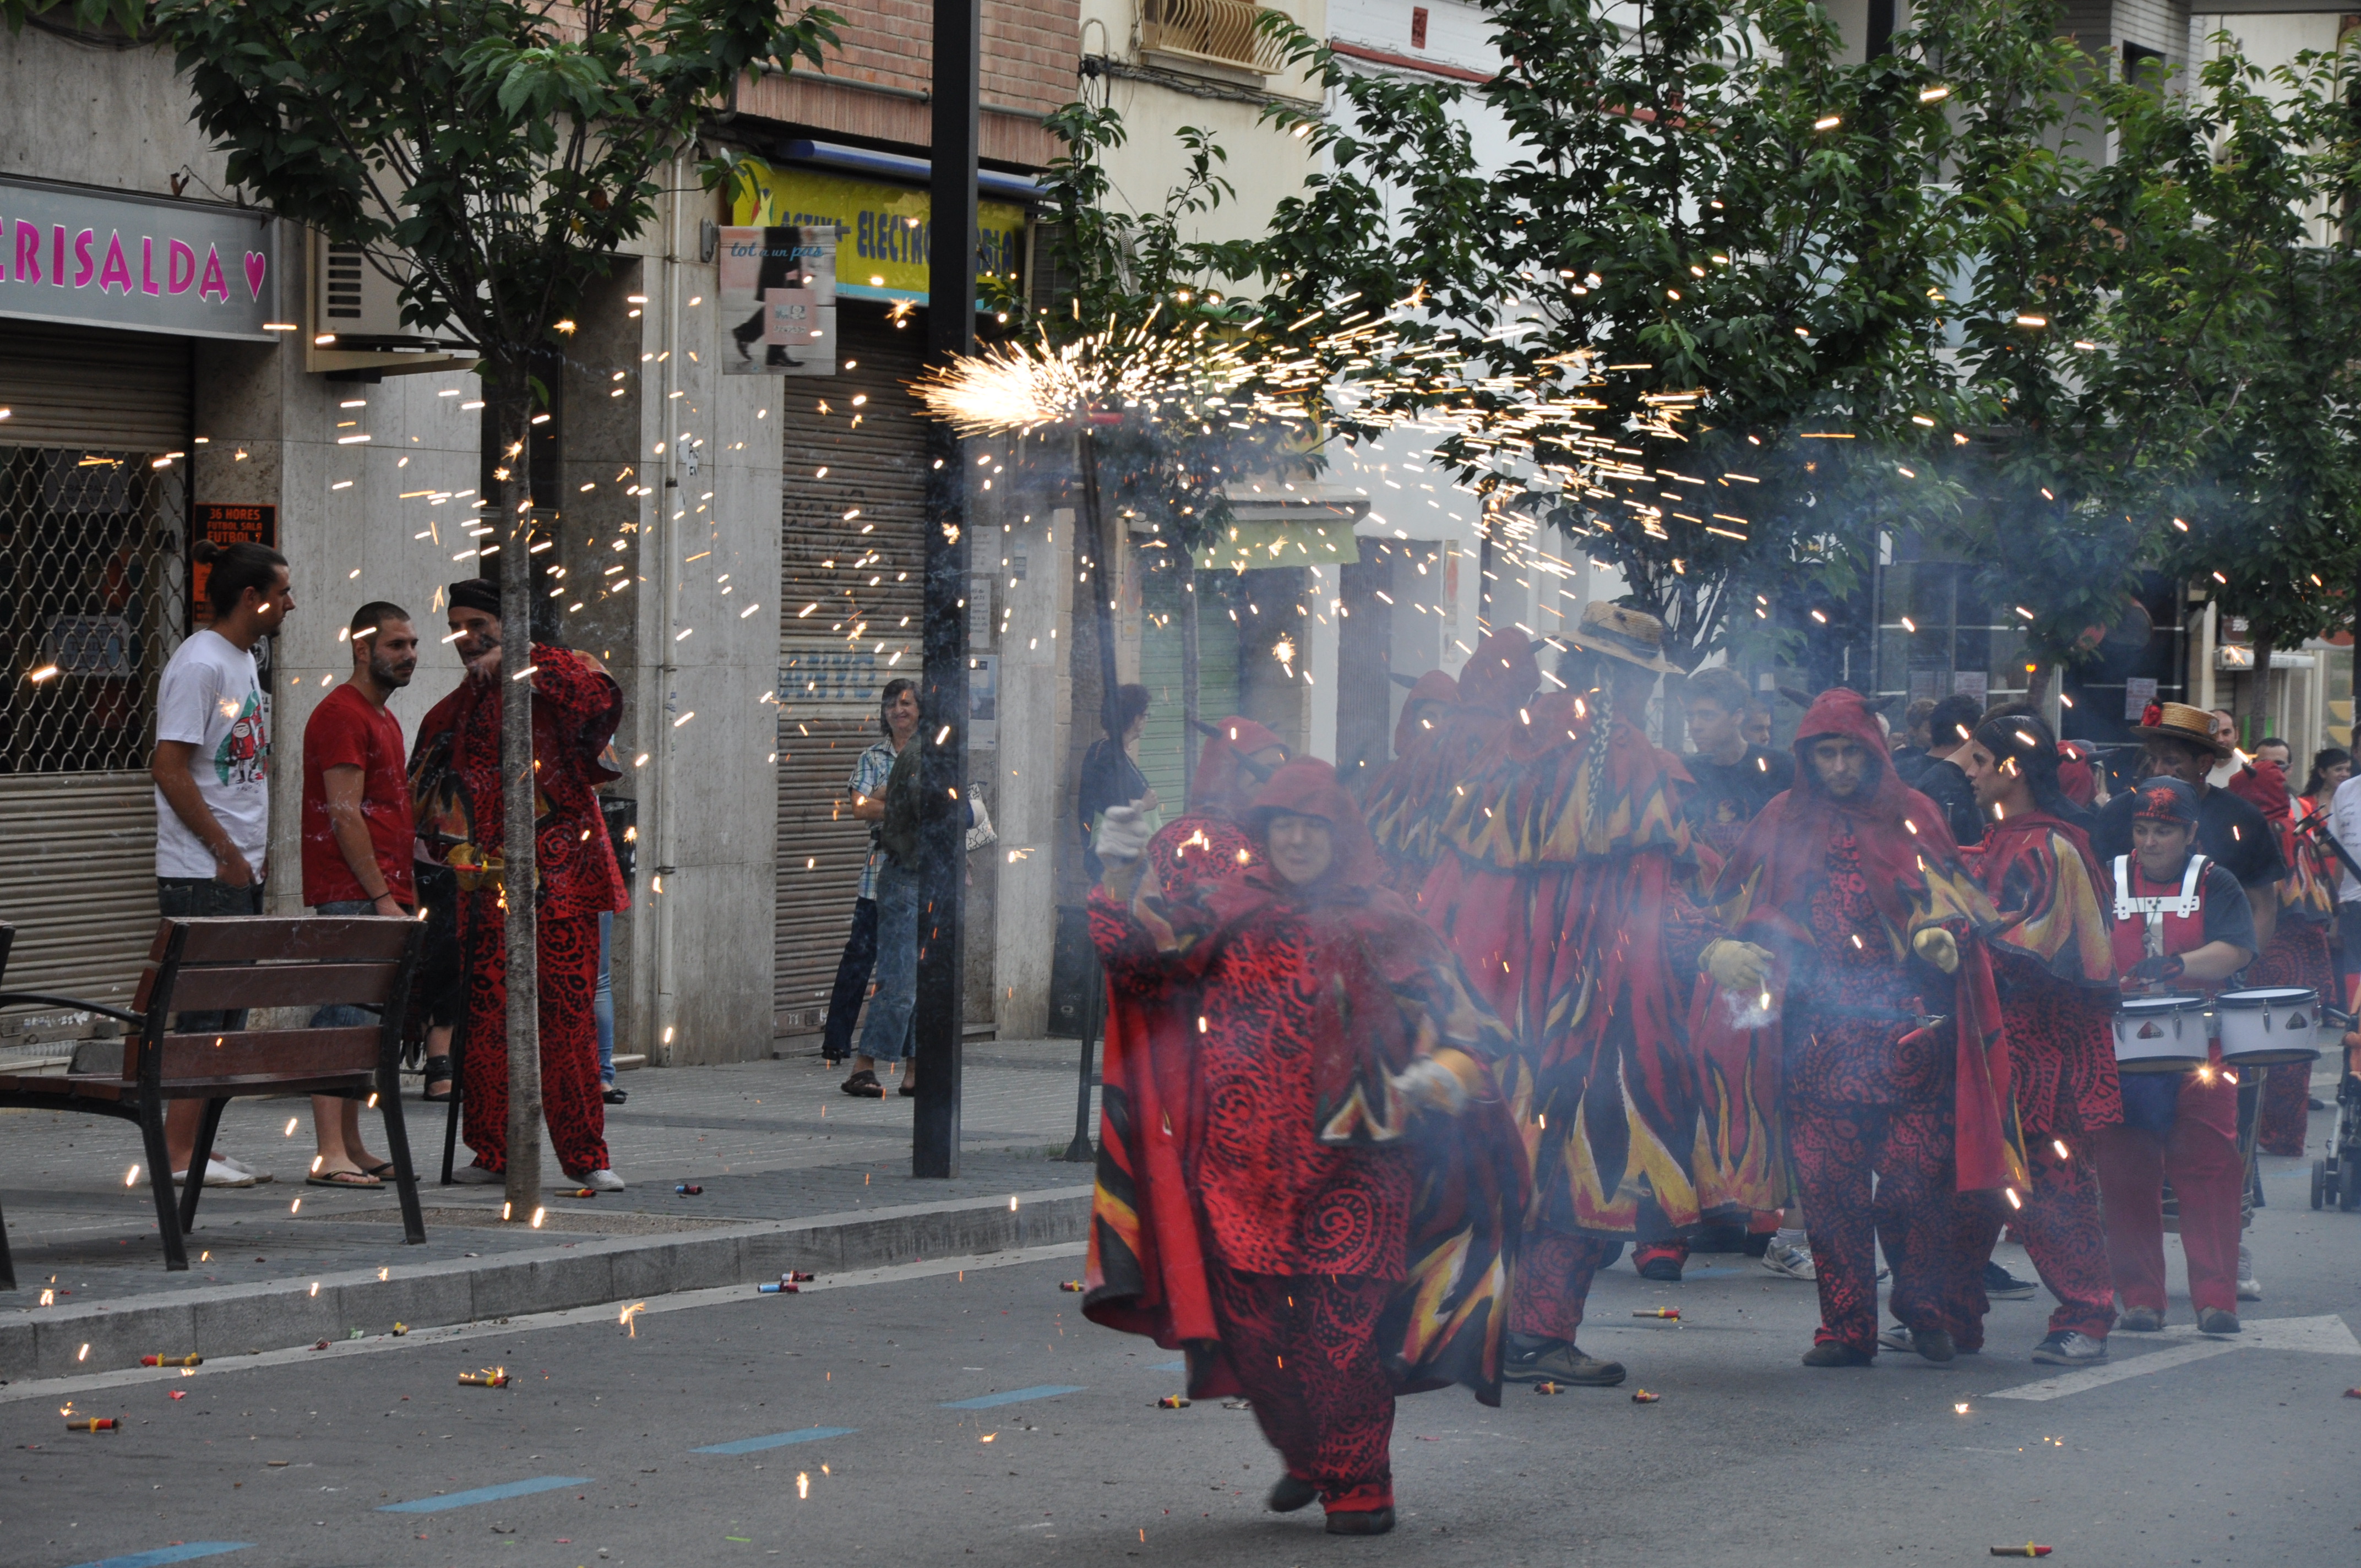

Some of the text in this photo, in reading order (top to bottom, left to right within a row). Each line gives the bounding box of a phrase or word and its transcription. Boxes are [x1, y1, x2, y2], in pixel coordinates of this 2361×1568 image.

[731, 242, 757, 257] tot
[789, 246, 824, 262] pas
[0, 216, 230, 304] RISALDA
[209, 508, 260, 520] 36 HORES
[207, 521, 263, 531] FUTBOL SALA
[207, 531, 262, 543] FUTBOL 7
